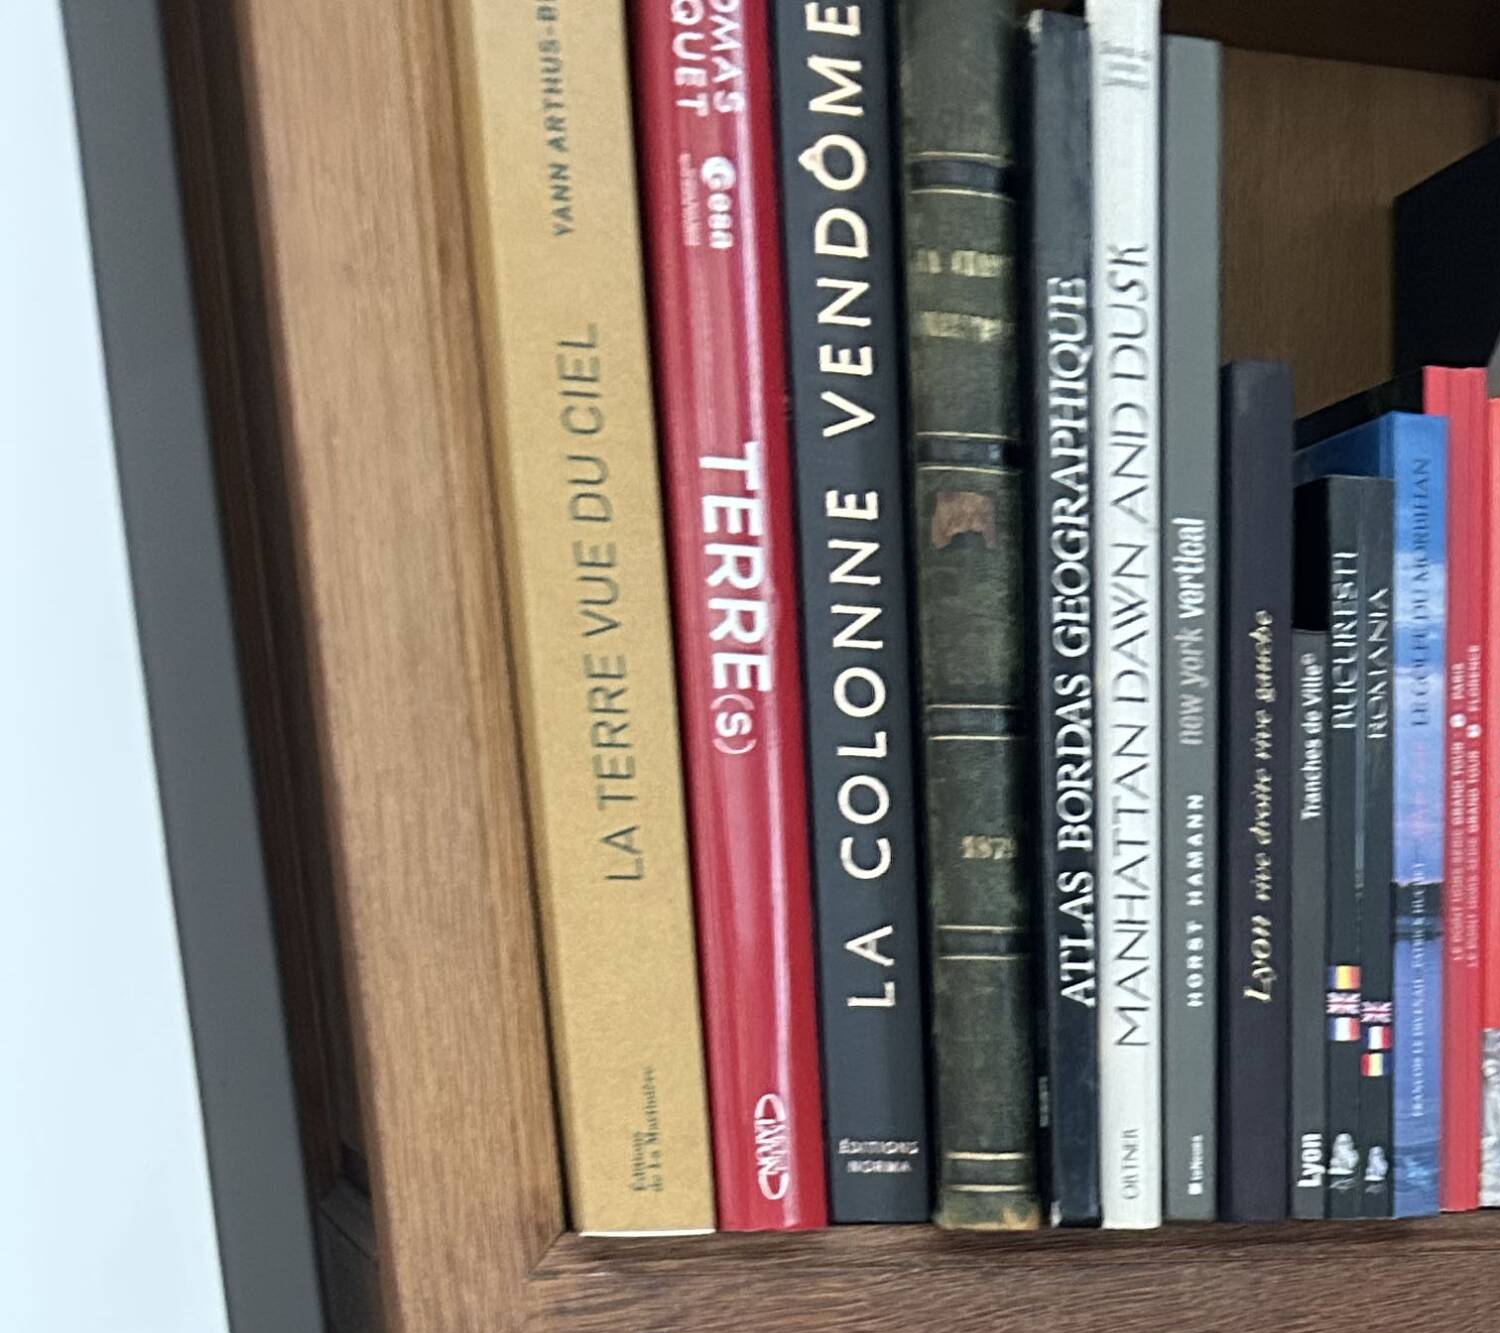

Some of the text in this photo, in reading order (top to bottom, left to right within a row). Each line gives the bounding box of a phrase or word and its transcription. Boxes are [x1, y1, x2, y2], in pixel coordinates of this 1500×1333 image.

[550, 166, 577, 237] YANN
[1104, 244, 1149, 380] DUSK
[798, 1, 896, 1009] LA COLONNE VENDÔME
[1110, 402, 1150, 524] AND
[1171, 517, 1207, 619] vertical
[1409, 458, 1432, 583] MORBIHAN
[556, 322, 645, 881] LA TERRE VUE DU CIEL
[704, 439, 769, 756] TERRE(s)
[1045, 277, 1097, 1009] ATLAS BORDAS GEOGRAPHIQUE
[1110, 543, 1150, 704] DAWN
[1173, 628, 1211, 689] york
[1247, 611, 1278, 704] gauche
[1366, 587, 1390, 740] ROMANIA
[1177, 692, 1206, 746] new
[1300, 710, 1323, 735] de
[1246, 768, 1273, 846] droite
[1298, 738, 1322, 821] Tranches
[1111, 723, 1151, 1048] MANHATTAN
[1185, 795, 1205, 907] HAMANN
[1185, 920, 1205, 1008] HORST
[1242, 914, 1279, 1004] Lyon
[1295, 1134, 1326, 1188] Lyon
